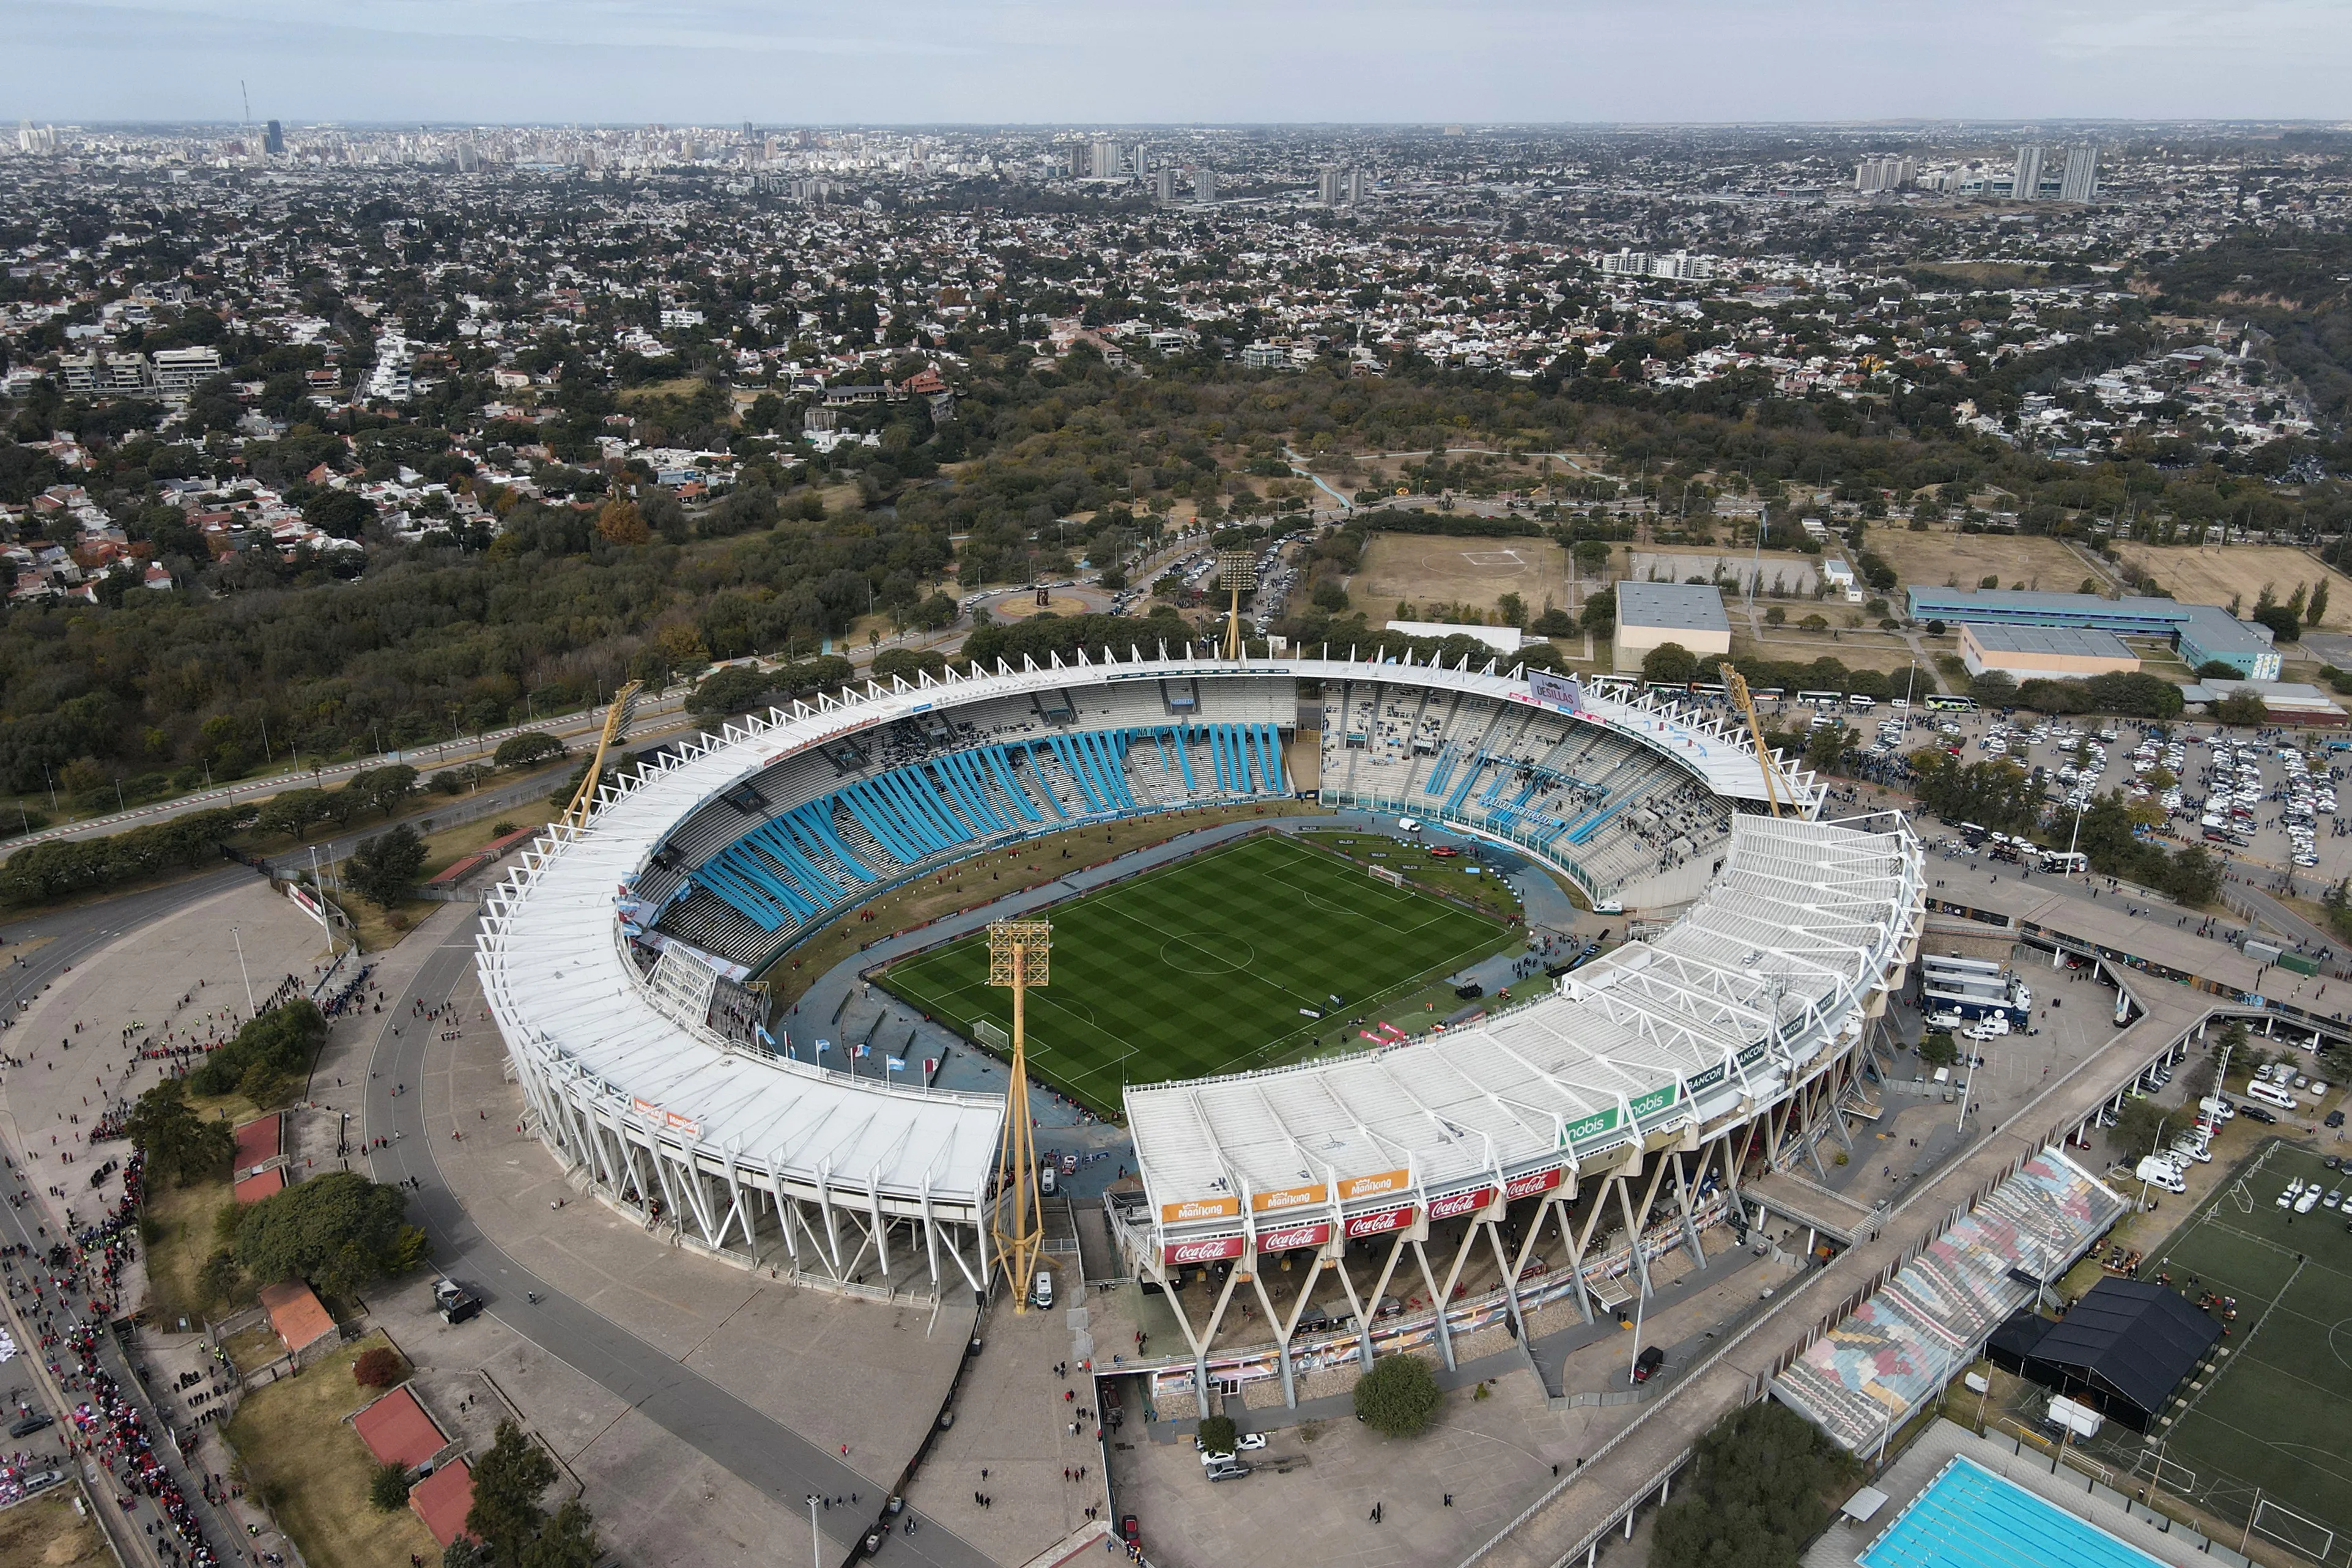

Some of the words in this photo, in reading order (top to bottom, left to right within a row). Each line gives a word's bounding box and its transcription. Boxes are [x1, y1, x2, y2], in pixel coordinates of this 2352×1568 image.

[1536, 685, 1574, 704] DESILLAS
[1492, 798, 1514, 812] BARRA
[1734, 1042, 1764, 1067] ANCOR
[1506, 1174, 1547, 1199] Coca-Cola
[1430, 1193, 1476, 1218] Coca-Cola
[1350, 1211, 1399, 1236] Coca-Cola
[1265, 1228, 1315, 1250] Coca-Cola
[1174, 1241, 1226, 1262] Coca-Cola
